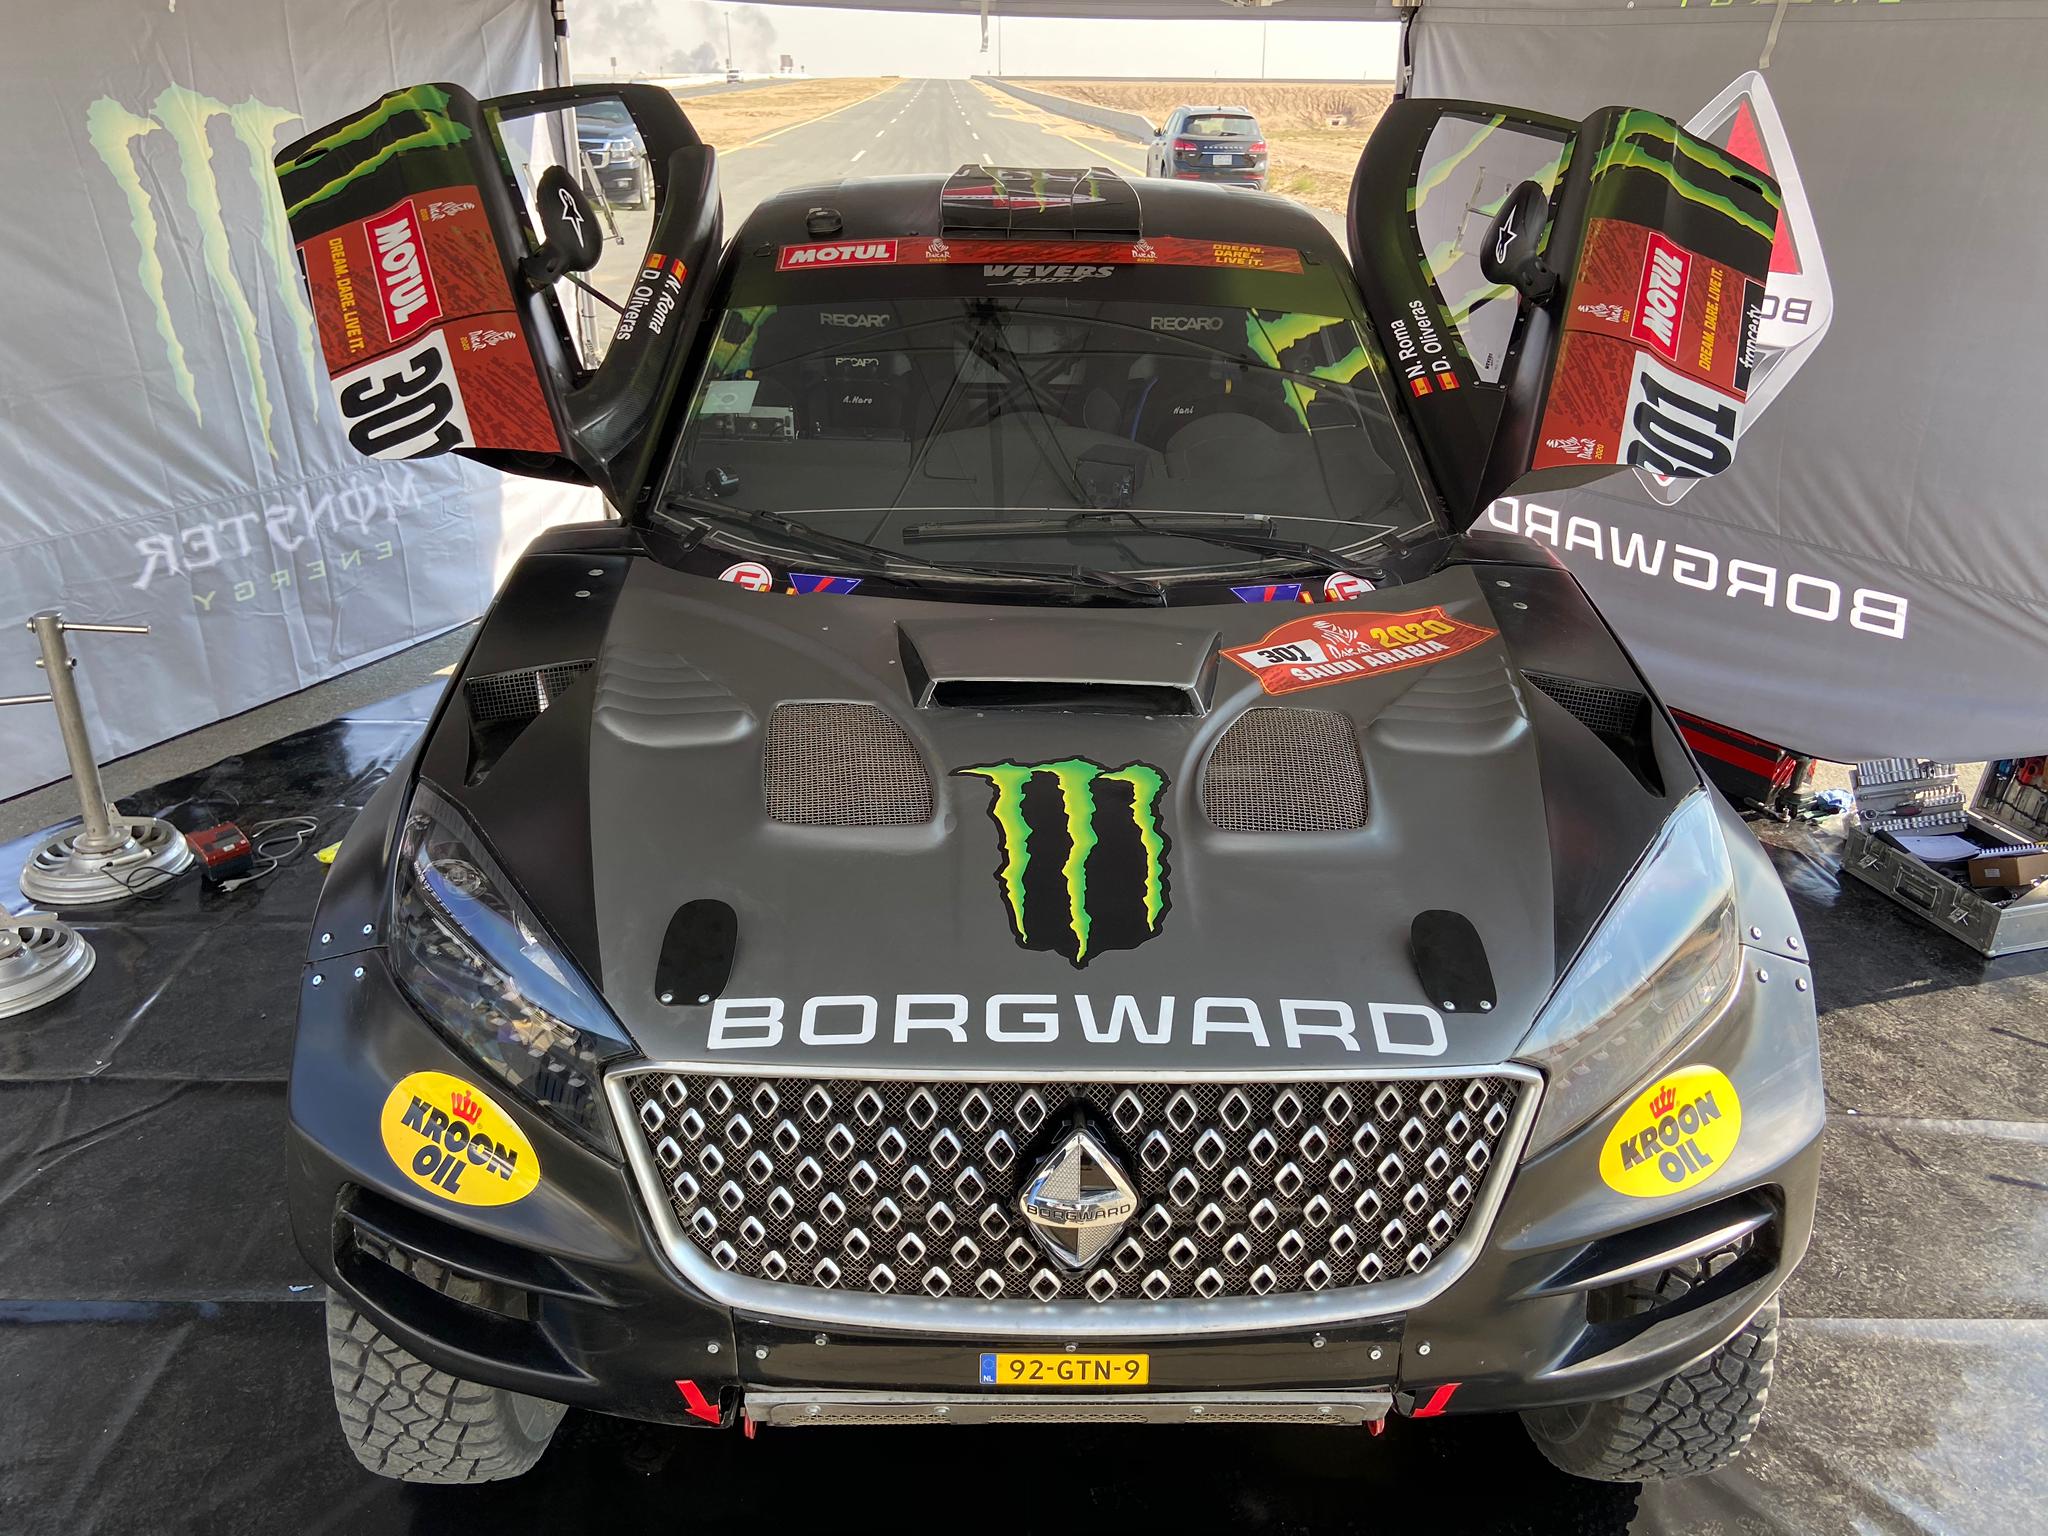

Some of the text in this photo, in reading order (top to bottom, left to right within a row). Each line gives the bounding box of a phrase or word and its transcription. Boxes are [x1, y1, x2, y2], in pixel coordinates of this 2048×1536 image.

[789, 243, 891, 264] MOTUL
[1212, 243, 1265, 254] DREAM.
[1214, 250, 1254, 259] DARE.
[1215, 256, 1264, 266] LIVE IT.
[374, 218, 428, 325] MOTUL
[983, 264, 1116, 278] WEVERS
[329, 237, 365, 353] DREAM. DARE. LIVE IT.
[616, 269, 660, 340] D. Oliveras
[649, 274, 681, 334] N. Roma
[1642, 248, 1683, 347] MOTUL
[1151, 316, 1224, 330] RECARO
[1408, 300, 1451, 372] D. Oliveras
[1699, 267, 1723, 371] DREAM. DARE. LIVE IT.
[1390, 319, 1426, 379] N. Roma
[1576, 438, 1597, 460] DAKAR
[1257, 644, 1313, 664] 301
[1326, 641, 1380, 659] DAKAR
[1369, 619, 1456, 649] 2020
[1290, 640, 1450, 682] SAUDI ARABIA
[706, 993, 1450, 1057] BORGWARD
[401, 1095, 518, 1181] KROON
[1620, 1090, 1722, 1171] KROON
[412, 1144, 467, 1195] OIL
[1658, 1138, 1714, 1183] OIL
[1027, 1204, 1131, 1221] BORGWARD
[1009, 1359, 1140, 1380] 92-GTN-9
